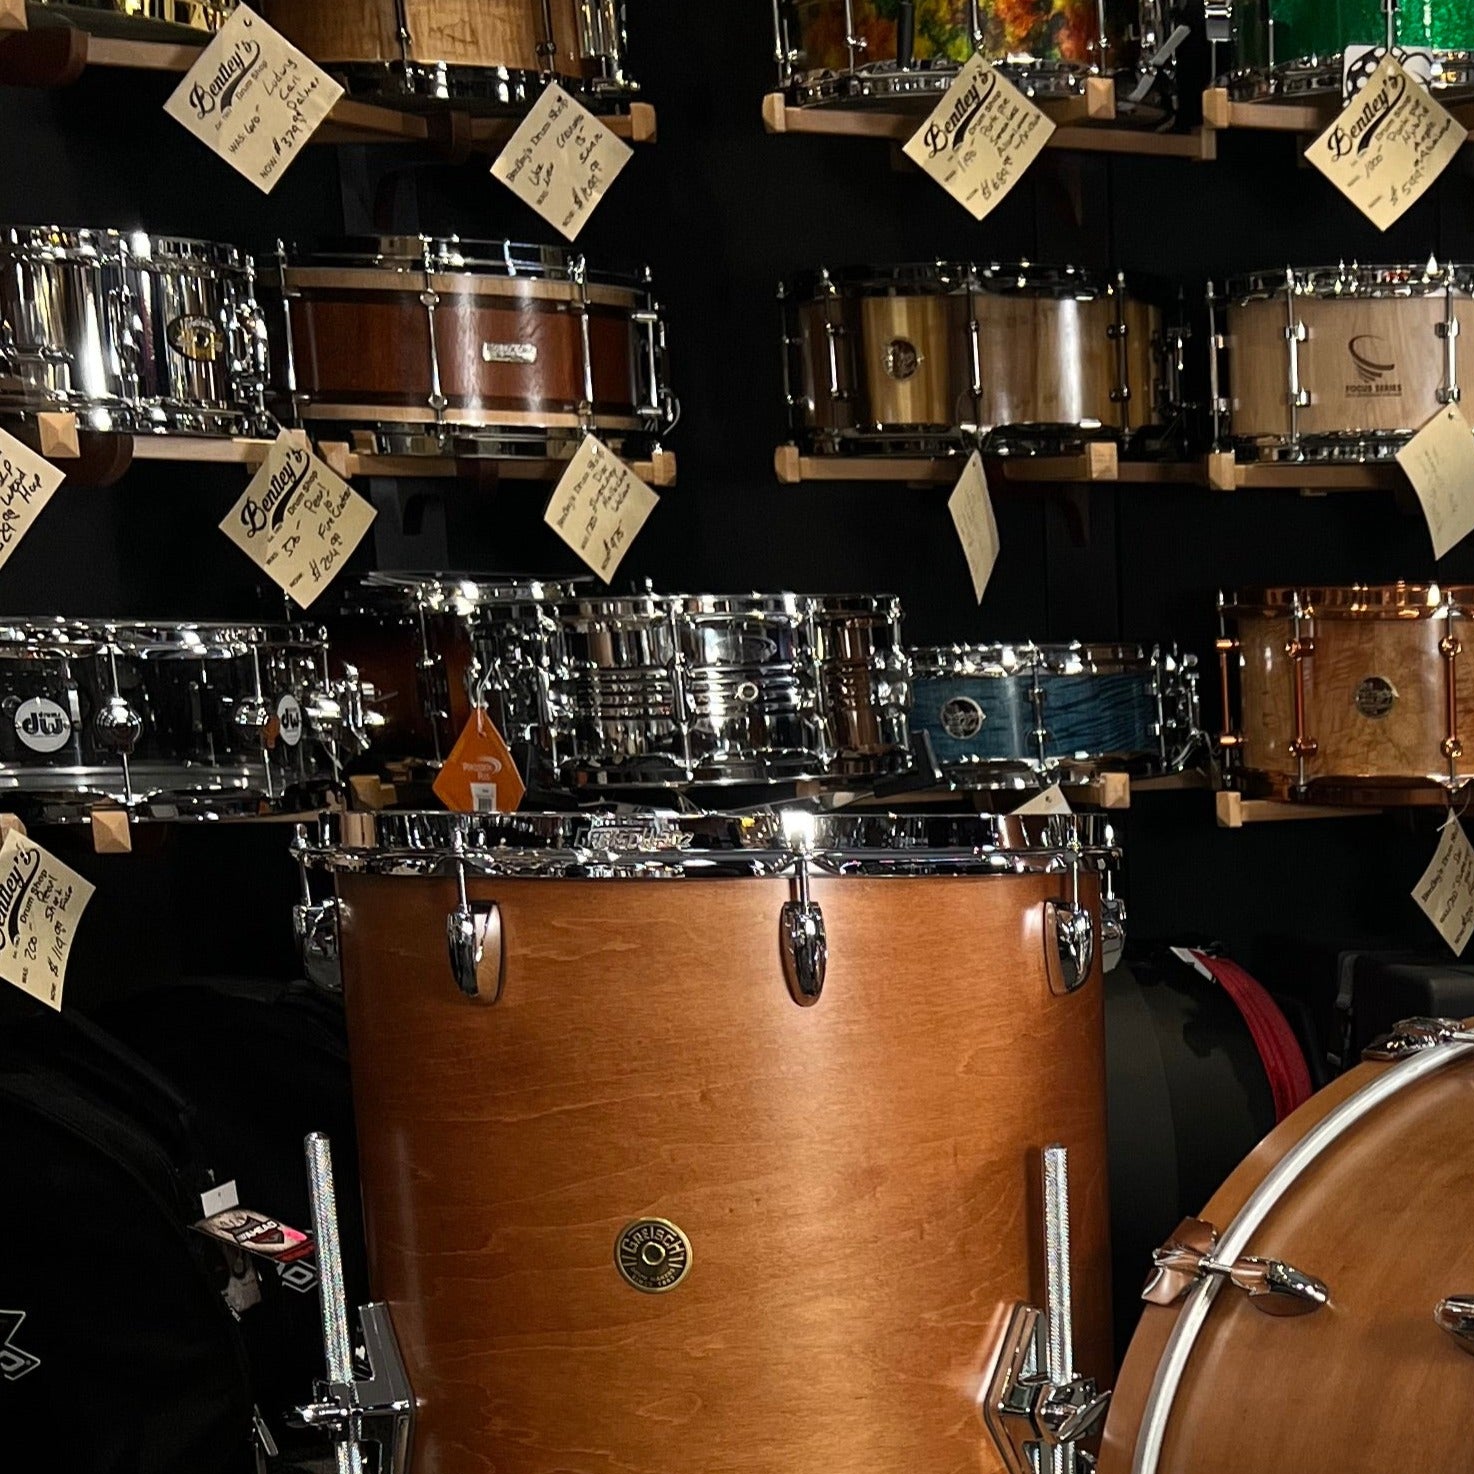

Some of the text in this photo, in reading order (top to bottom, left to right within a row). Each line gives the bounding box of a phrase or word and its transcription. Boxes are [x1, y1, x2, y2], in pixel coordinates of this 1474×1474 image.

[189, 41, 260, 119] Bentley's
[234, 59, 268, 101] Drum Shop
[923, 69, 996, 157] Bentley's
[1327, 72, 1406, 158] Bentley's
[240, 448, 310, 538] Bentley's
[286, 469, 318, 516] Drum Shop
[303, 482, 330, 514] Pearl
[14, 895, 34, 924] Drum
[30, 868, 51, 897] Shop
[620, 1223, 685, 1255] GRETSCH
